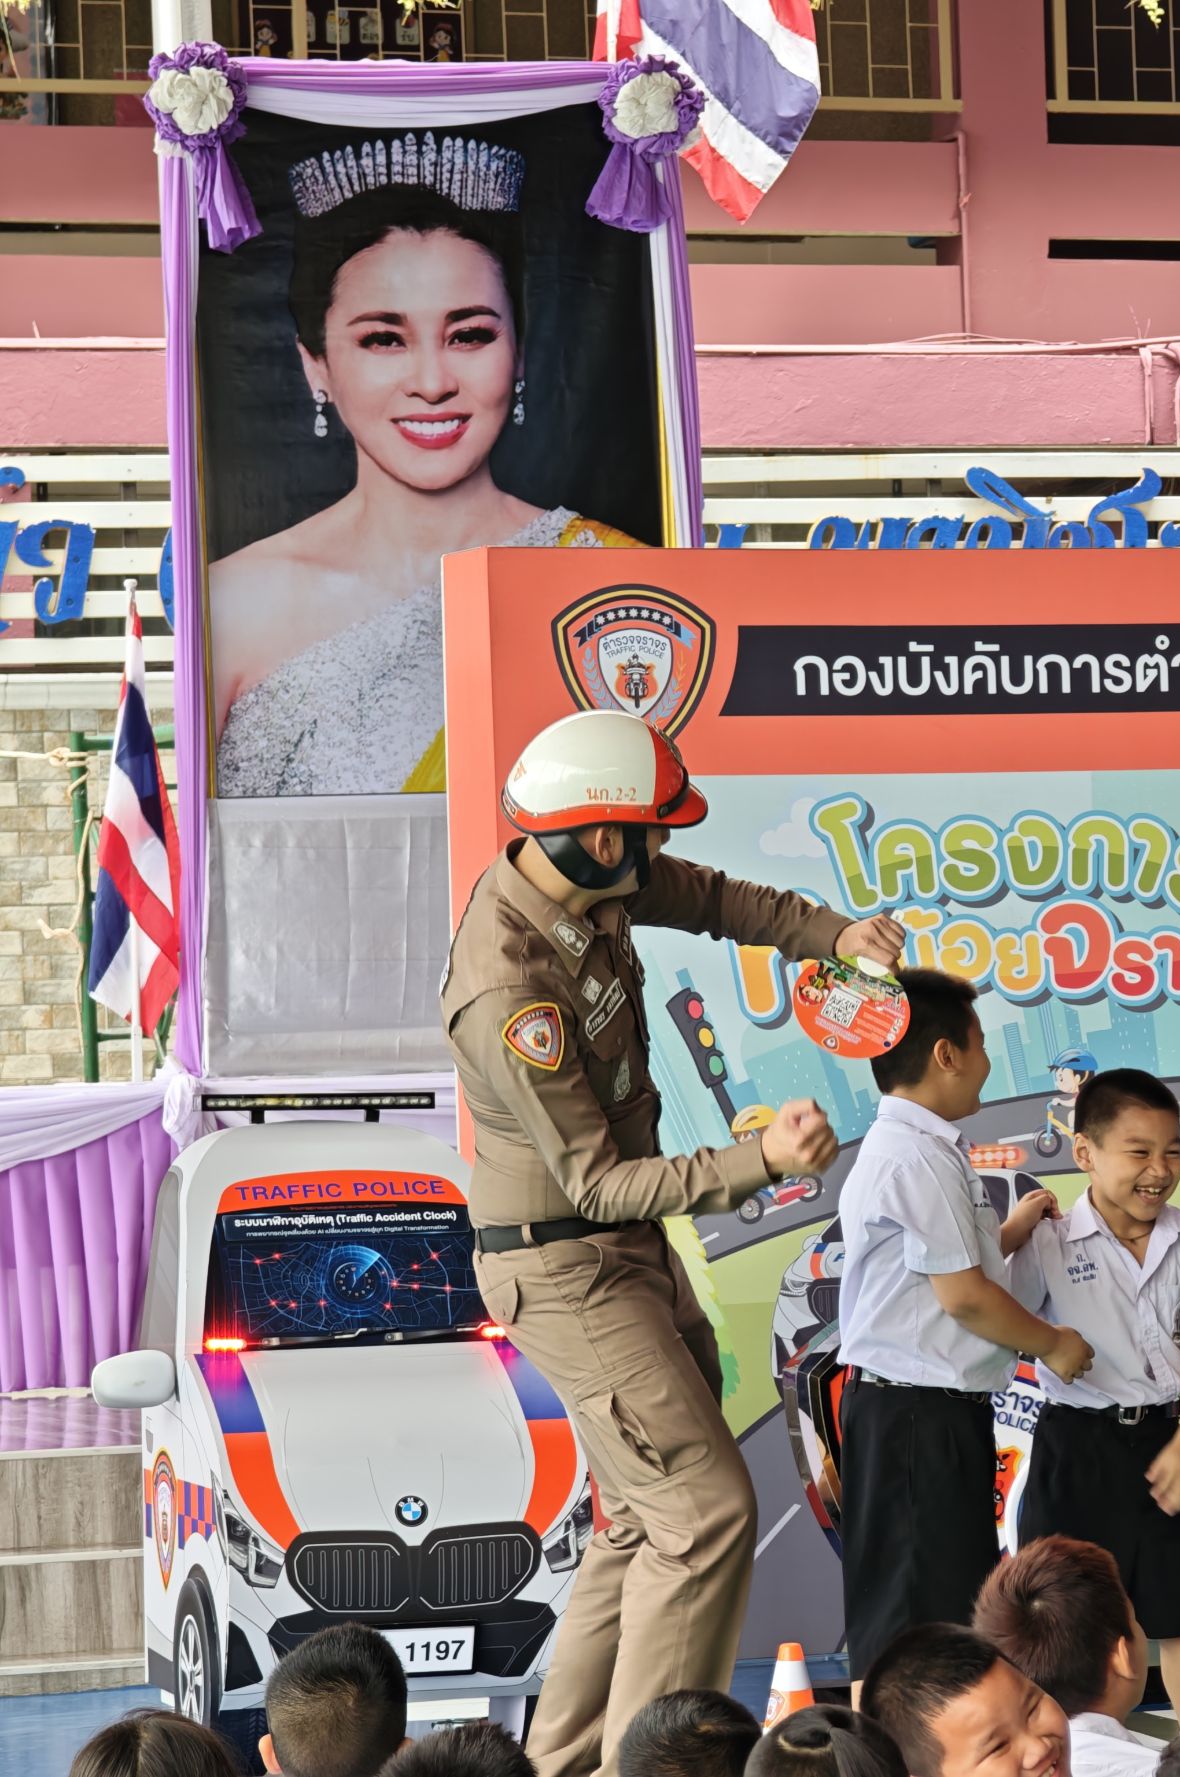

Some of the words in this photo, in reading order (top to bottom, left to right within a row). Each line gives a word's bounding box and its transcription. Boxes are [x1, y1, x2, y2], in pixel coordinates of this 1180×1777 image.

[606, 645, 636, 658] TRAFFIC
[638, 645, 665, 659] POLICE
[235, 1183, 343, 1201] TRAFFIC
[353, 1180, 446, 1198] POLICE
[336, 1213, 373, 1226] (Traffic
[375, 1210, 422, 1223] Accident
[423, 1209, 457, 1222] Clock)
[384, 1225, 403, 1233] Digital
[404, 1224, 450, 1232] Transformation
[398, 1497, 425, 1508] BMW
[405, 1640, 466, 1662] 1197
